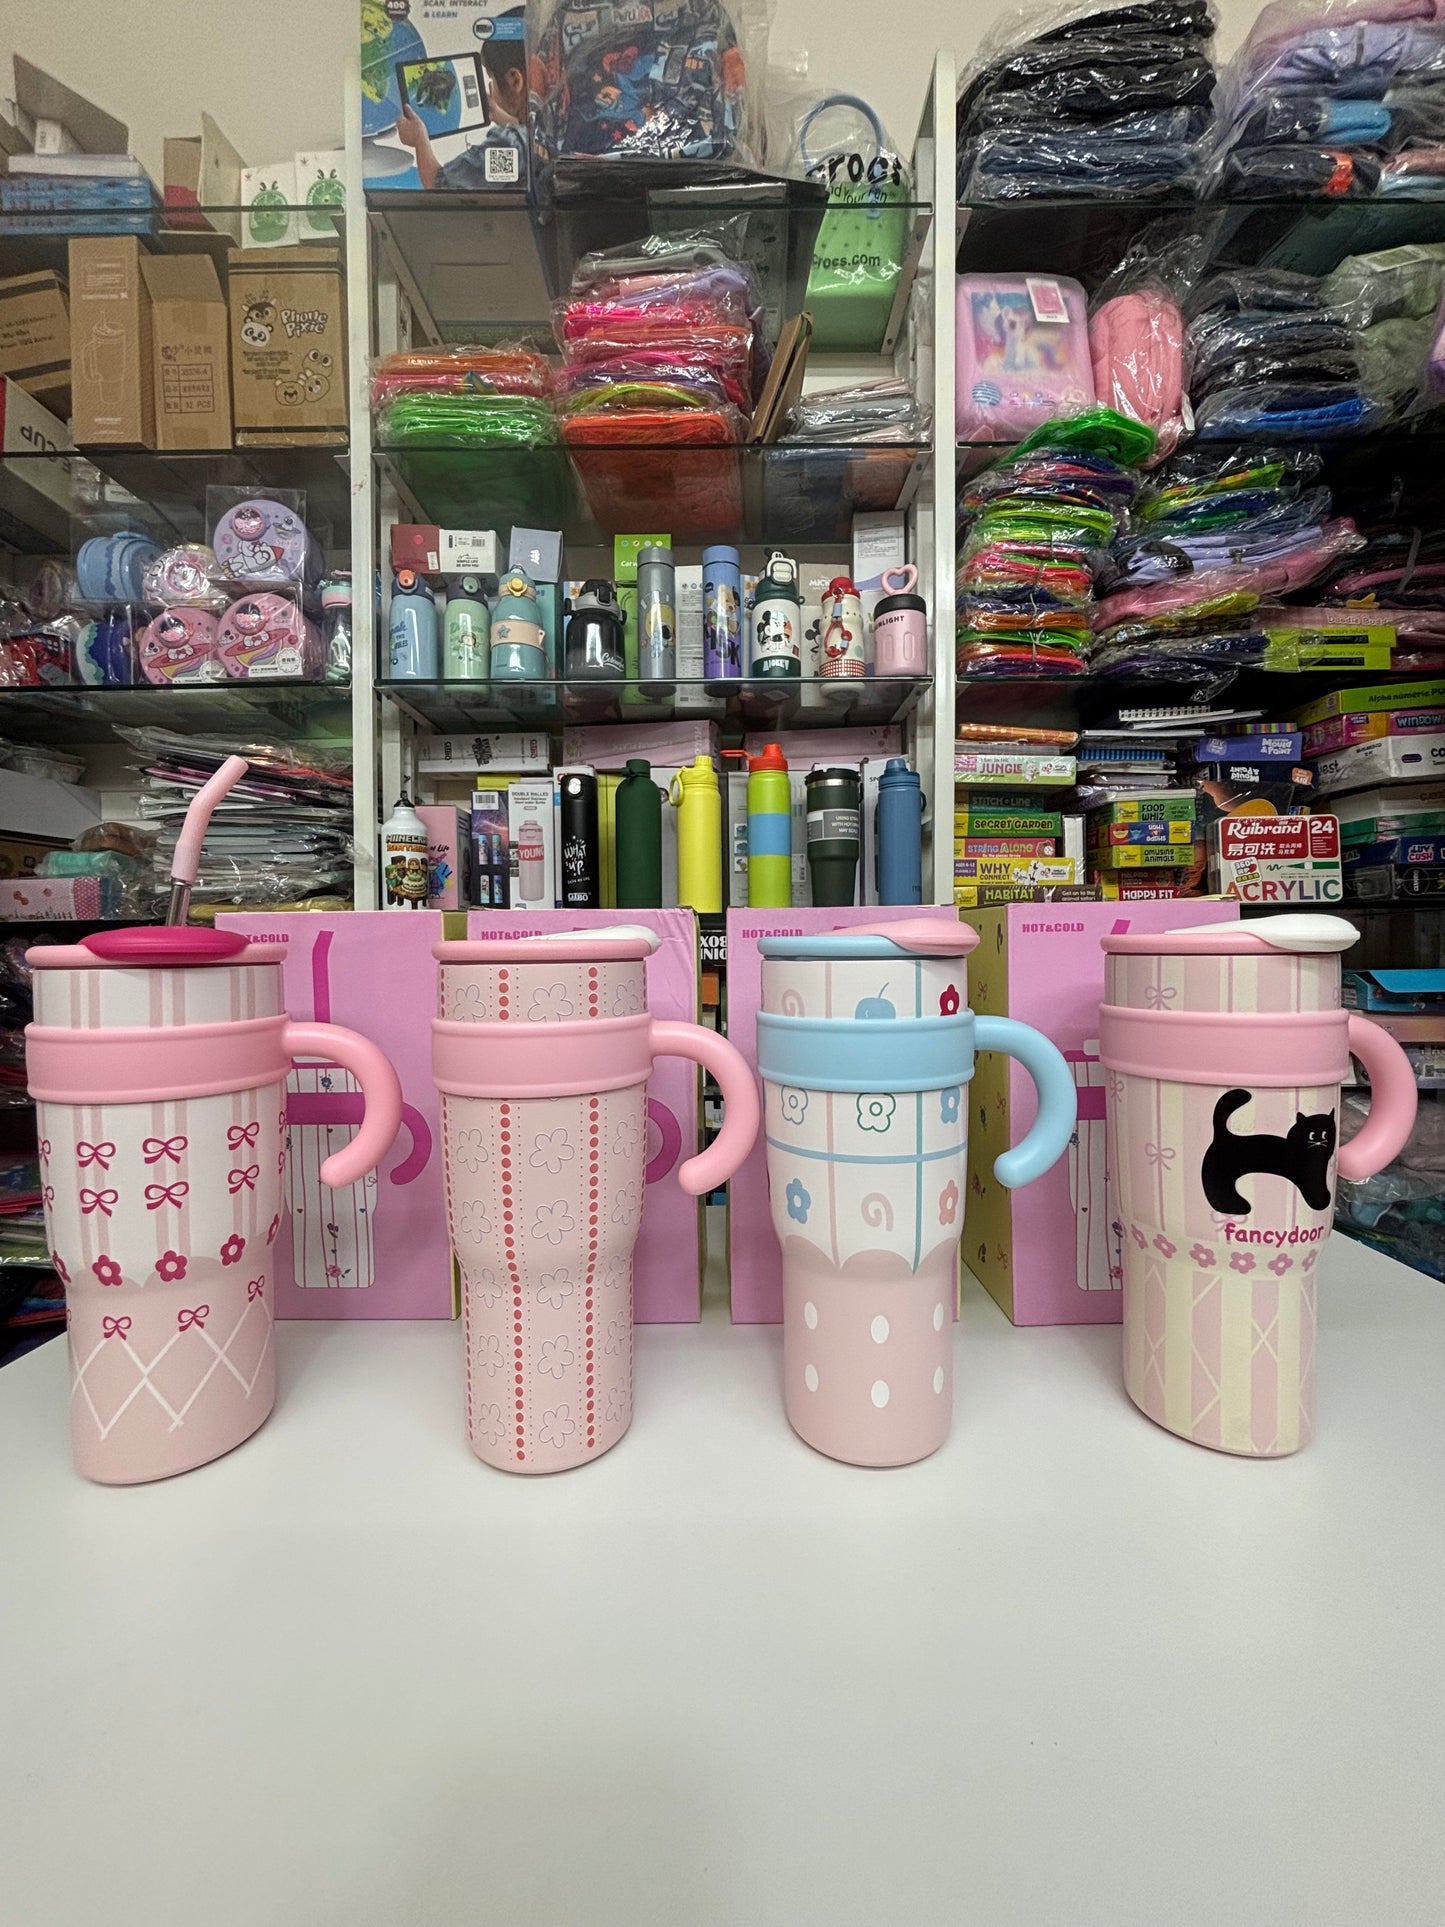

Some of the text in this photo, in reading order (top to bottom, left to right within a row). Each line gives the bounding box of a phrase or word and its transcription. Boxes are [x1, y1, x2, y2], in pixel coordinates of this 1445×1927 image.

[280, 308, 329, 325] Phone
[980, 763, 1023, 774] JUNGLE
[1227, 821, 1303, 839] Ruibrand
[1311, 820, 1335, 834] 24
[1227, 842, 1276, 856] 易可洗
[980, 863, 1012, 873] WHY
[985, 889, 1035, 900] HABITAT
[1158, 889, 1174, 899] FIT
[1225, 880, 1341, 901] ACRYLIC
[1022, 922, 1085, 933] HOT&COLD
[481, 930, 543, 940] HOT&COLD
[742, 929, 803, 939] HOT&COLD
[1224, 1222, 1324, 1248] fancydoor
